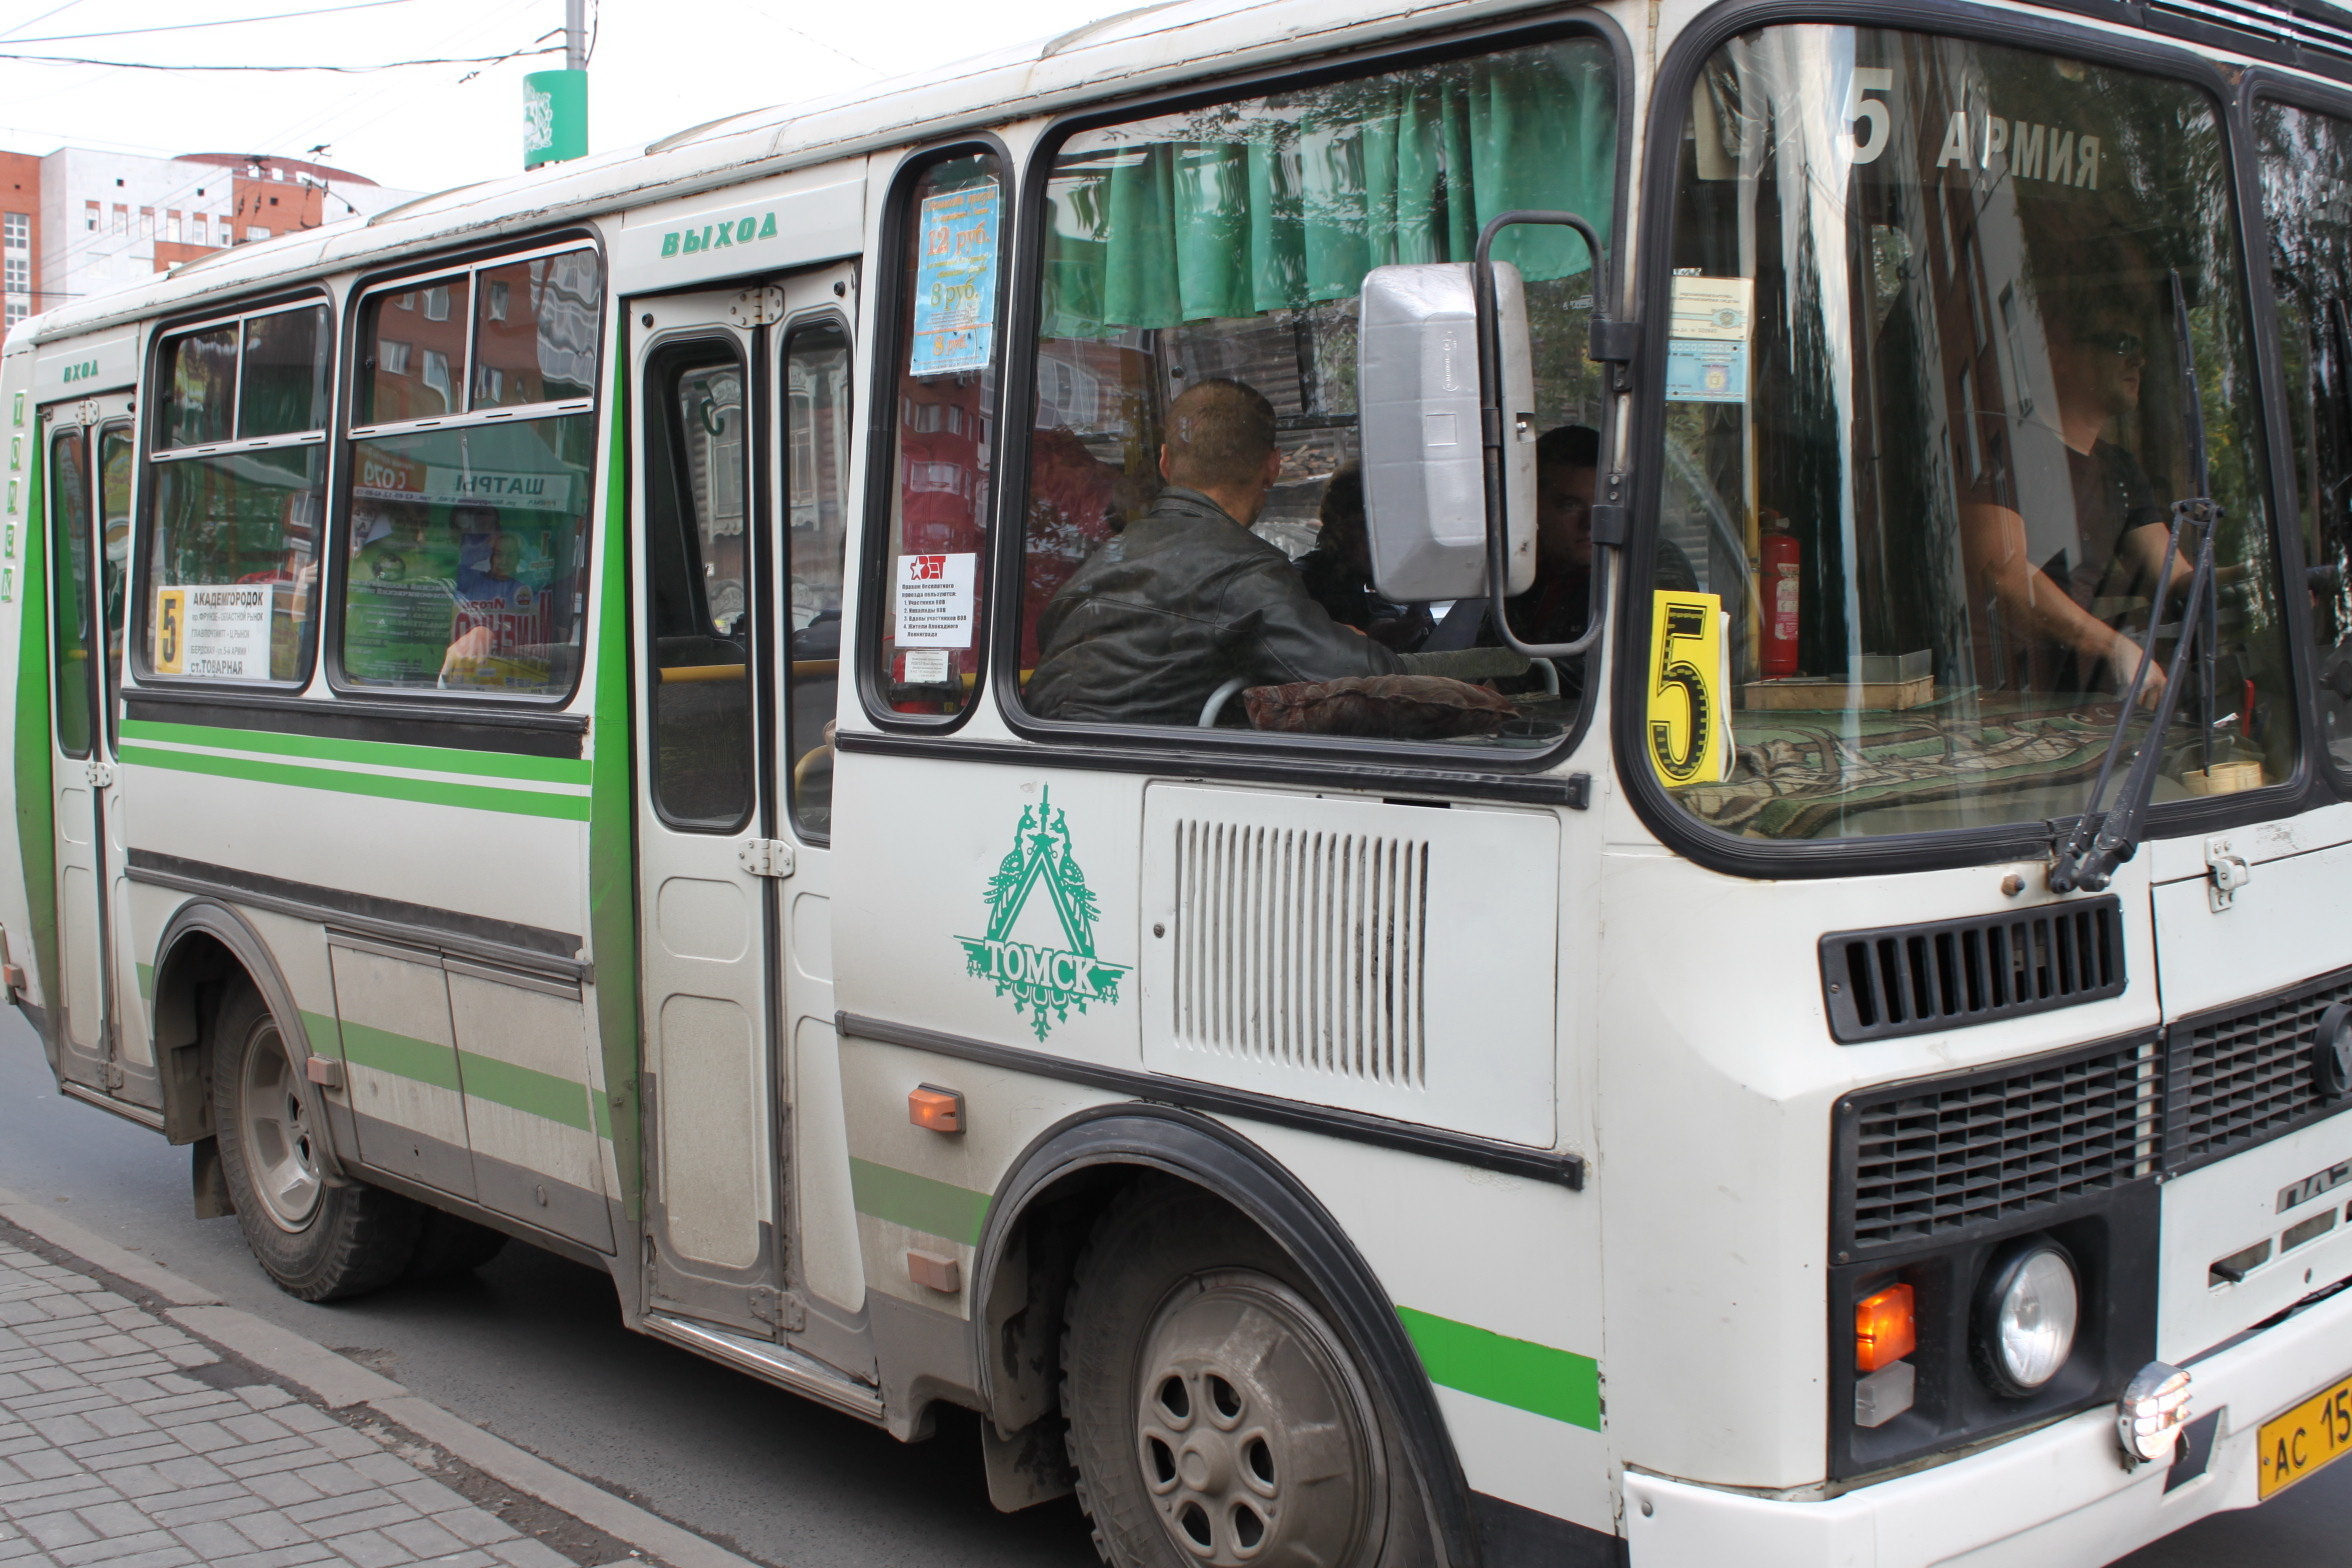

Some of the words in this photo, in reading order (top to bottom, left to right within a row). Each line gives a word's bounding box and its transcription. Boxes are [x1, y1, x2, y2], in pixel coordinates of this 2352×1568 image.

[1835, 67, 1893, 165] 5
[1936, 111, 2100, 190] АРМИЯ
[660, 212, 778, 259] ВЫХОД
[927, 226, 950, 256] 12
[954, 221, 992, 256] руб.
[930, 282, 942, 307] 8
[944, 277, 980, 311] руб.
[932, 335, 944, 356] 8
[63, 360, 99, 383] ВХОД
[193, 591, 264, 608] АКАДЕМГОРОДОК
[162, 598, 177, 663] 5
[1650, 602, 1710, 780] 5
[985, 940, 1098, 997] ТОМСК
[2320, 1388, 2352, 1450] 15
